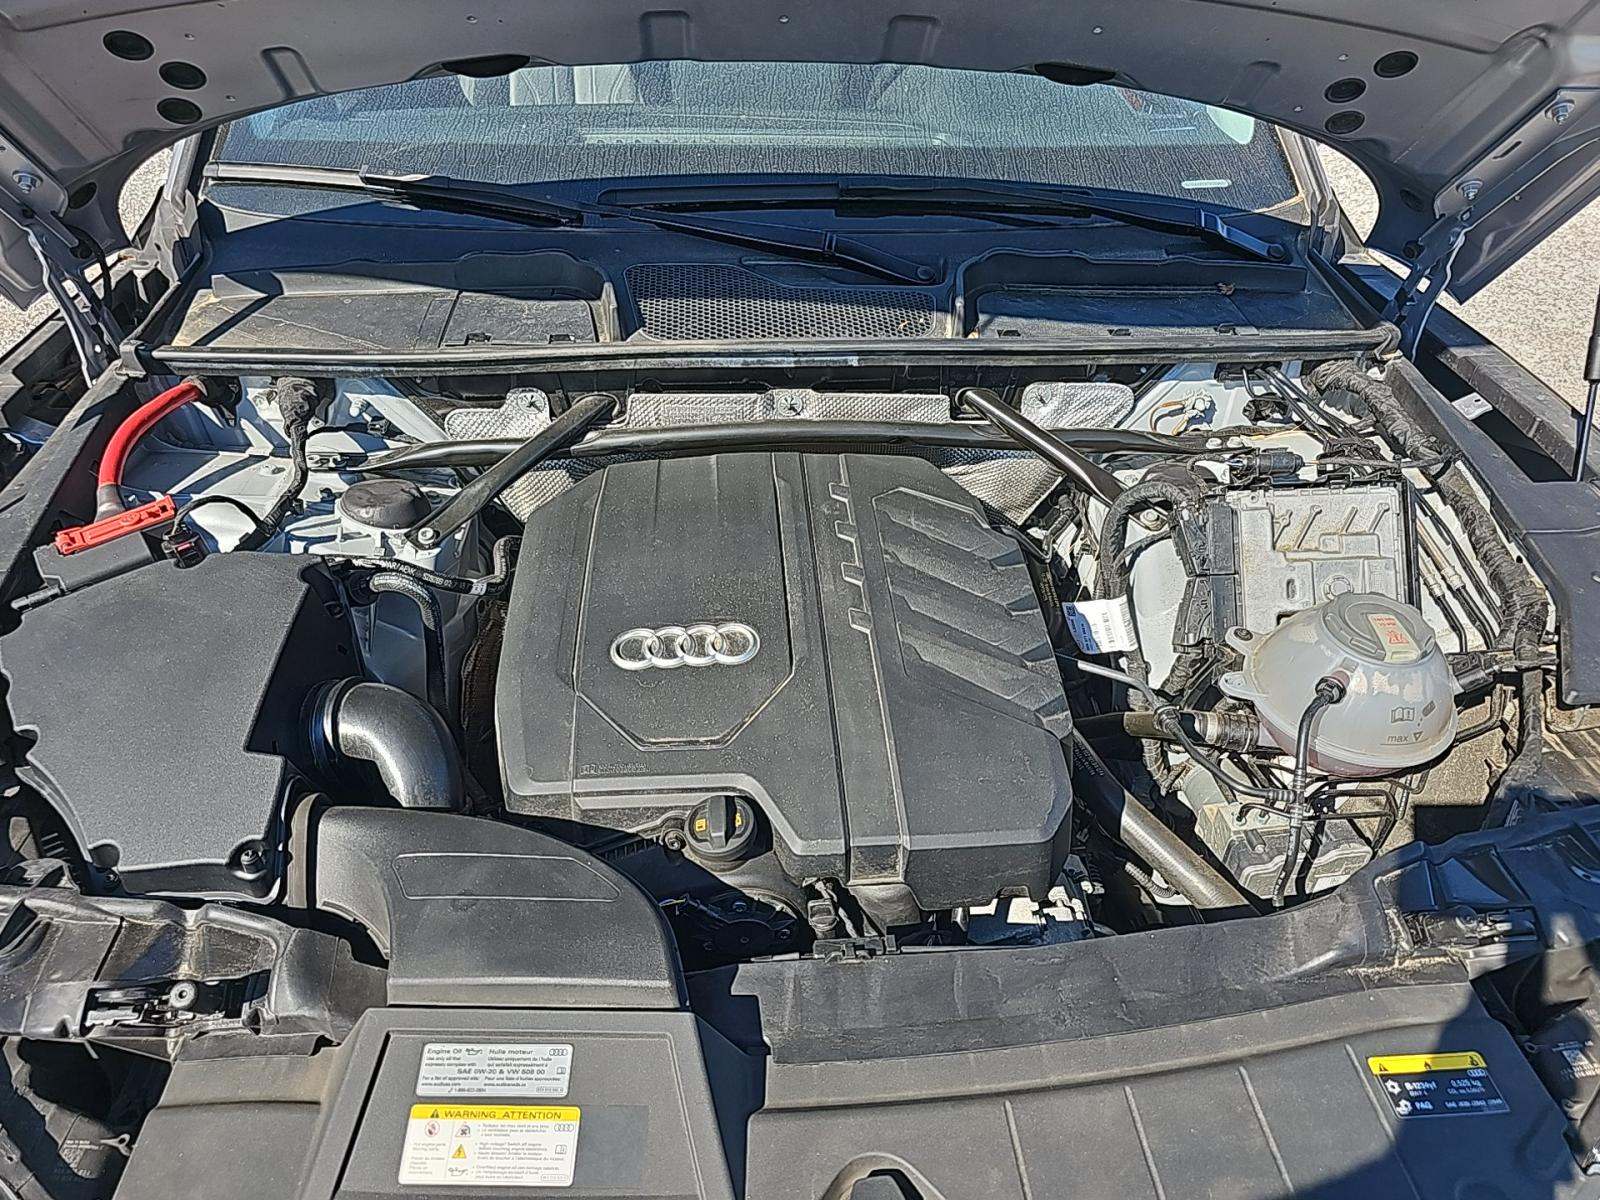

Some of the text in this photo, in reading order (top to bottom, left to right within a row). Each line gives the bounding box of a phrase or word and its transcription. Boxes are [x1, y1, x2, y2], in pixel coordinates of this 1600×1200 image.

[1386, 734, 1409, 742] max
[444, 1110, 562, 1120] WARNING ATTENTION
